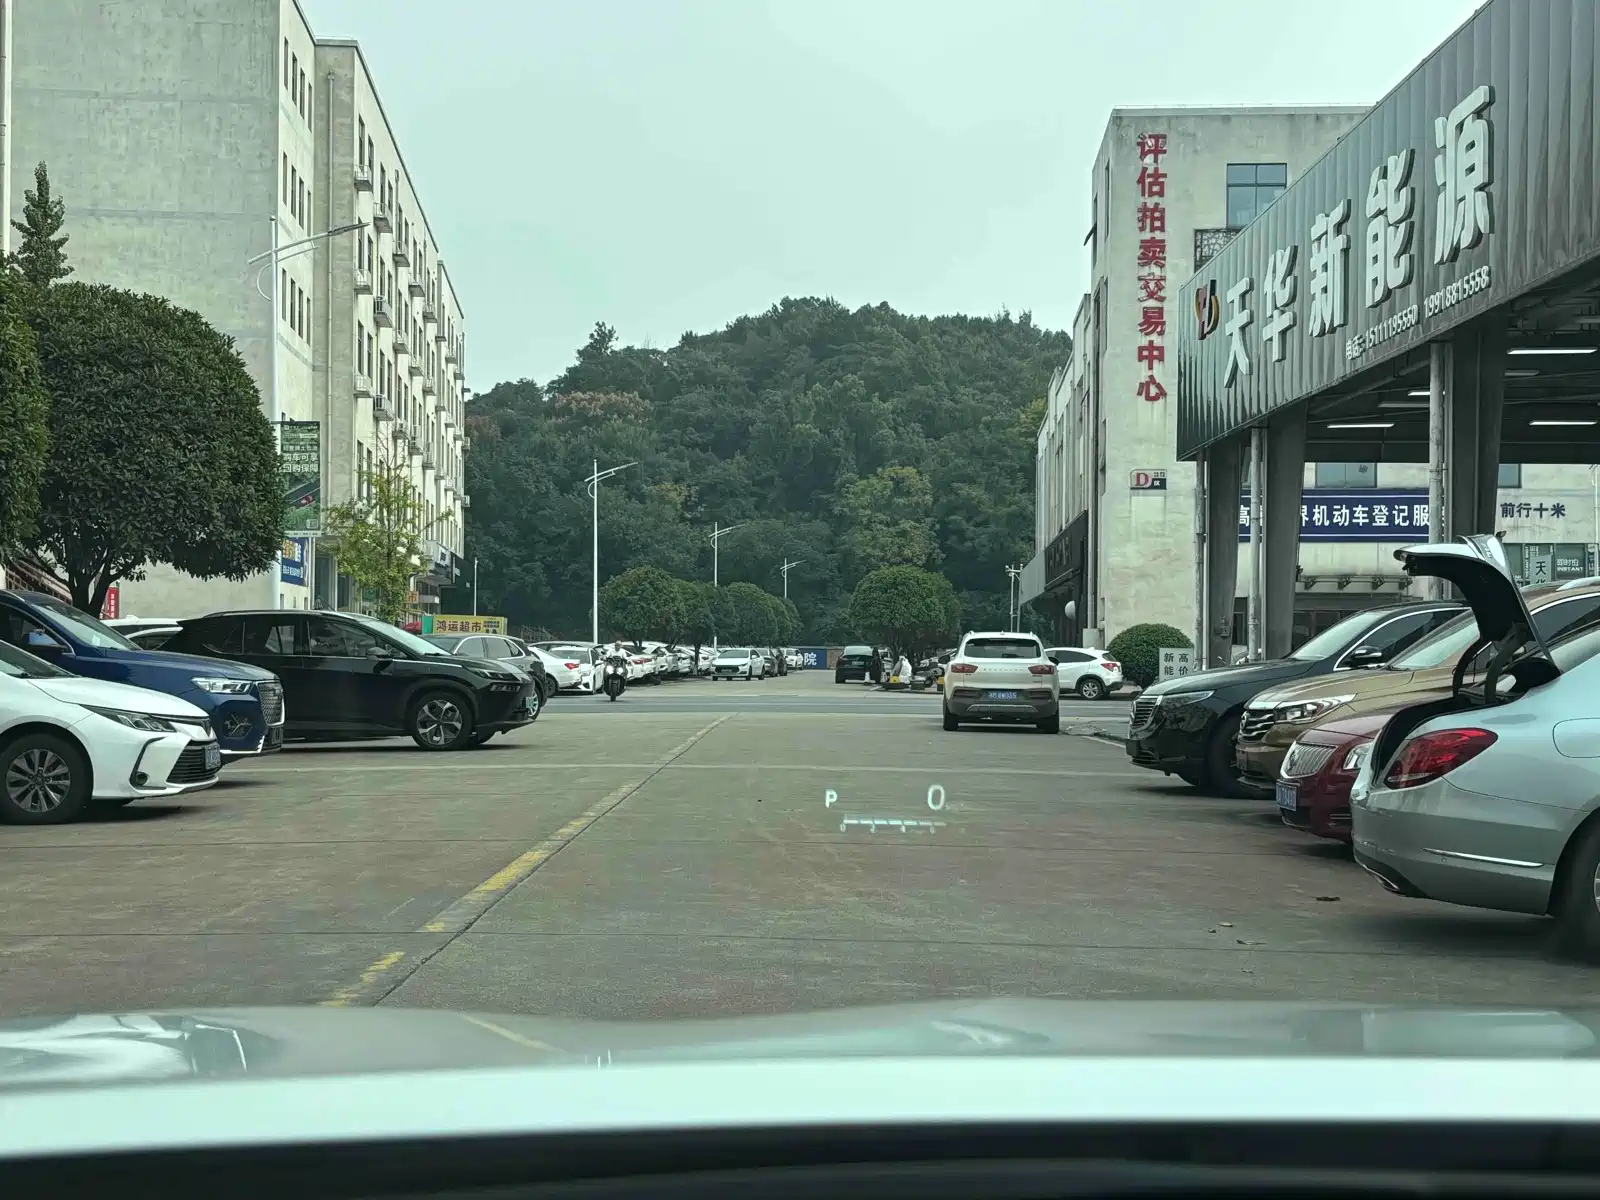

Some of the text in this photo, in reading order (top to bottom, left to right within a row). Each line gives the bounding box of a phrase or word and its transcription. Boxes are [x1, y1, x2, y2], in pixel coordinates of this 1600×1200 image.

[1224, 85, 1495, 388] 天华新能源
[1137, 133, 1168, 402] 评估拍卖交易中心
[1423, 265, 1492, 319] 19918815558
[1500, 502, 1567, 519] 前行十米
[436, 620, 482, 632] 鸿运超市
[825, 784, 945, 810] P 0
